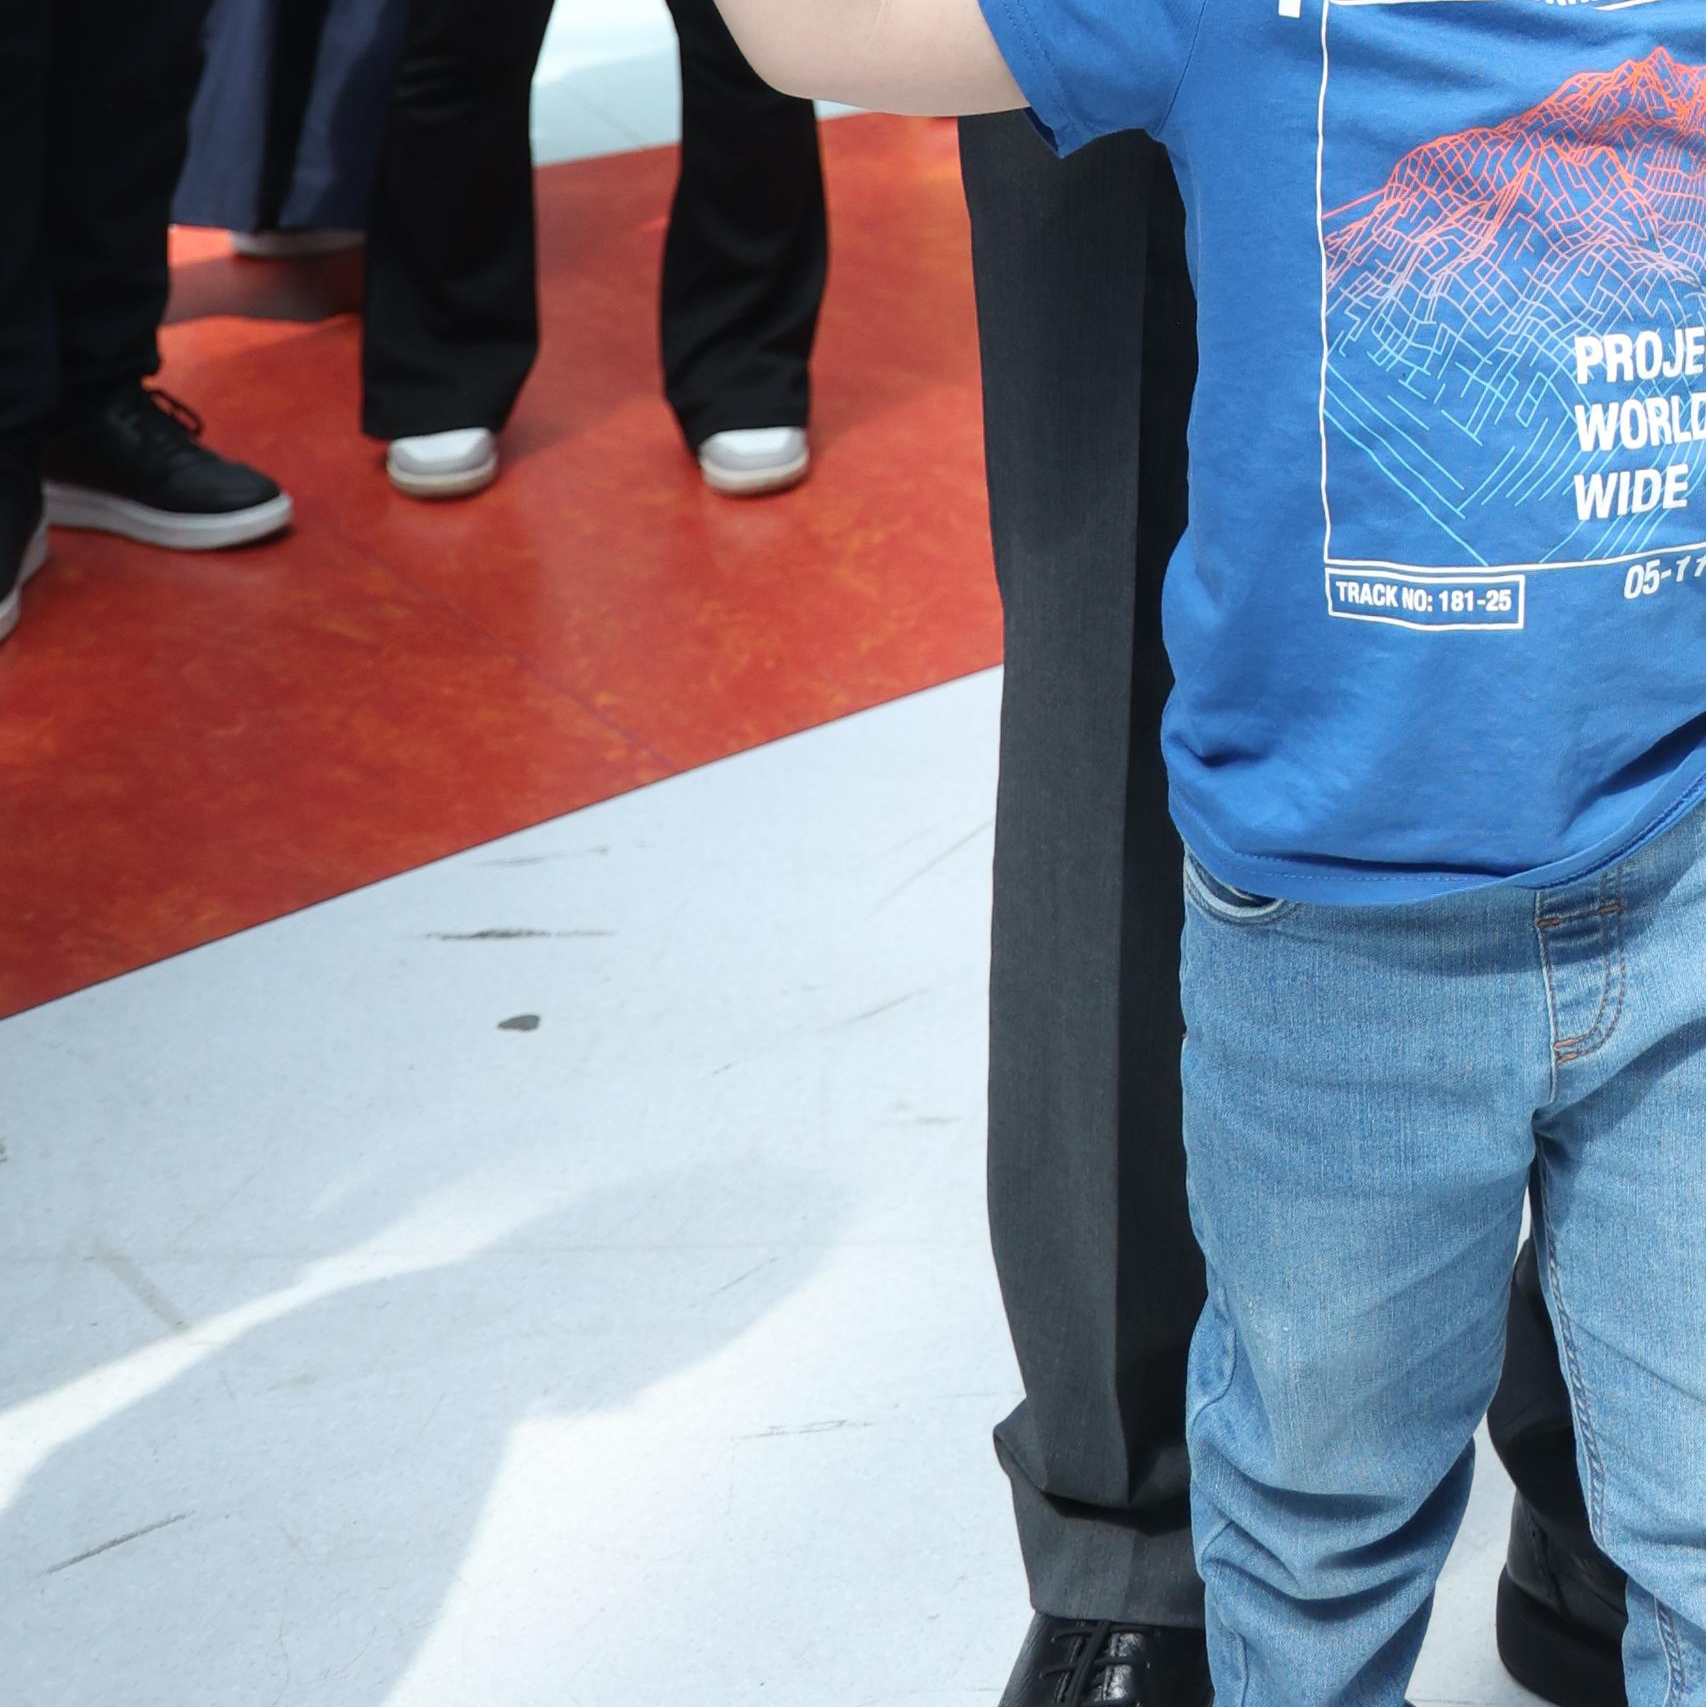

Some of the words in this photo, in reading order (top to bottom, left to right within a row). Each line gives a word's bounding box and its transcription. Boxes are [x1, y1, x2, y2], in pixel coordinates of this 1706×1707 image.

[1573, 463, 1690, 521] WIDE
[1335, 580, 1399, 608] TRACK
[1402, 586, 1434, 612] NO:
[1438, 588, 1512, 612] 181-25
